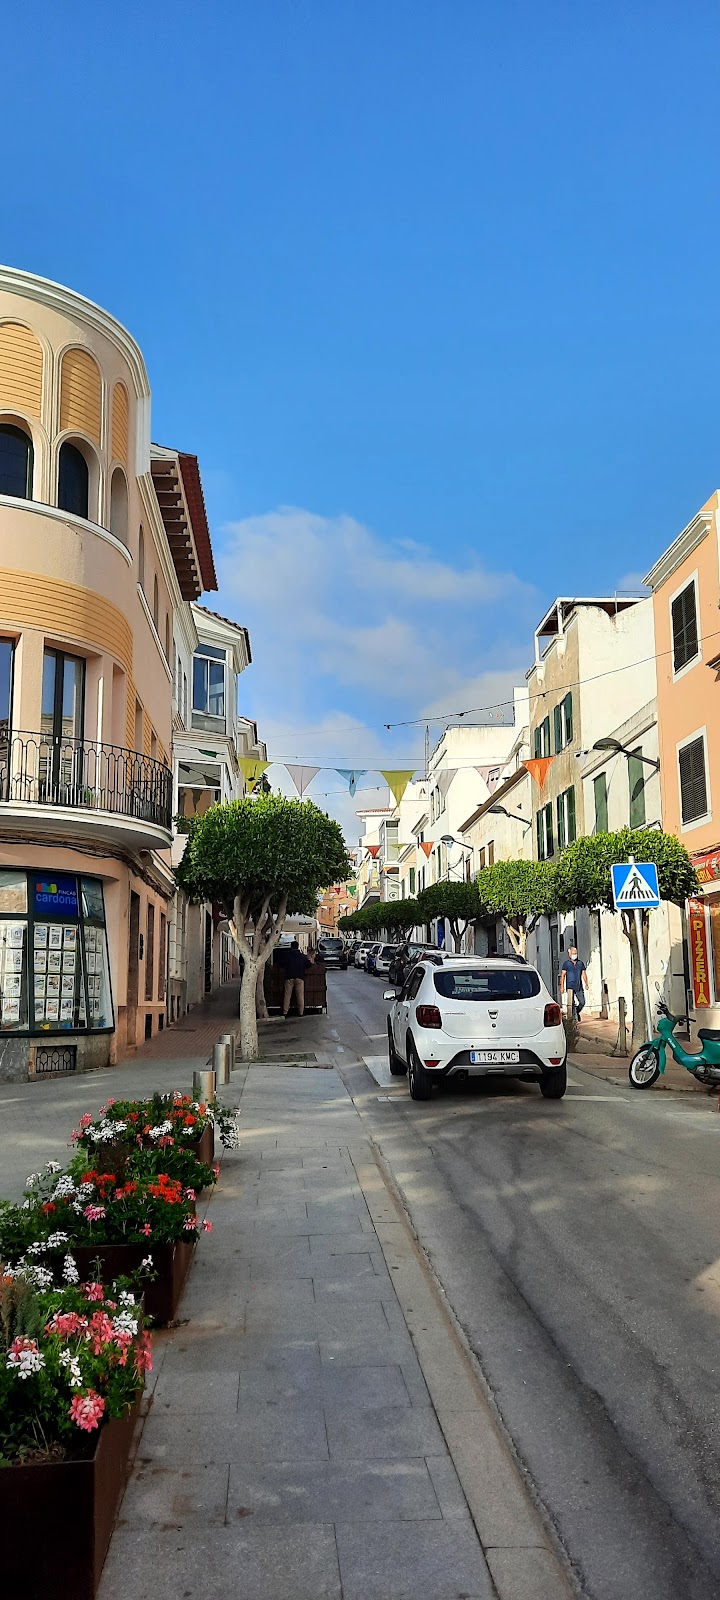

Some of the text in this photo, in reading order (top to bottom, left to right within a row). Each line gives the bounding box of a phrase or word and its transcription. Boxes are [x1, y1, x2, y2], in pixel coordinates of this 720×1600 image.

[696, 868, 713, 882] ERIA
[35, 893, 77, 905] cardona
[693, 920, 708, 1004] PIZZERIA
[478, 1052, 516, 1061] 1194 KMC
